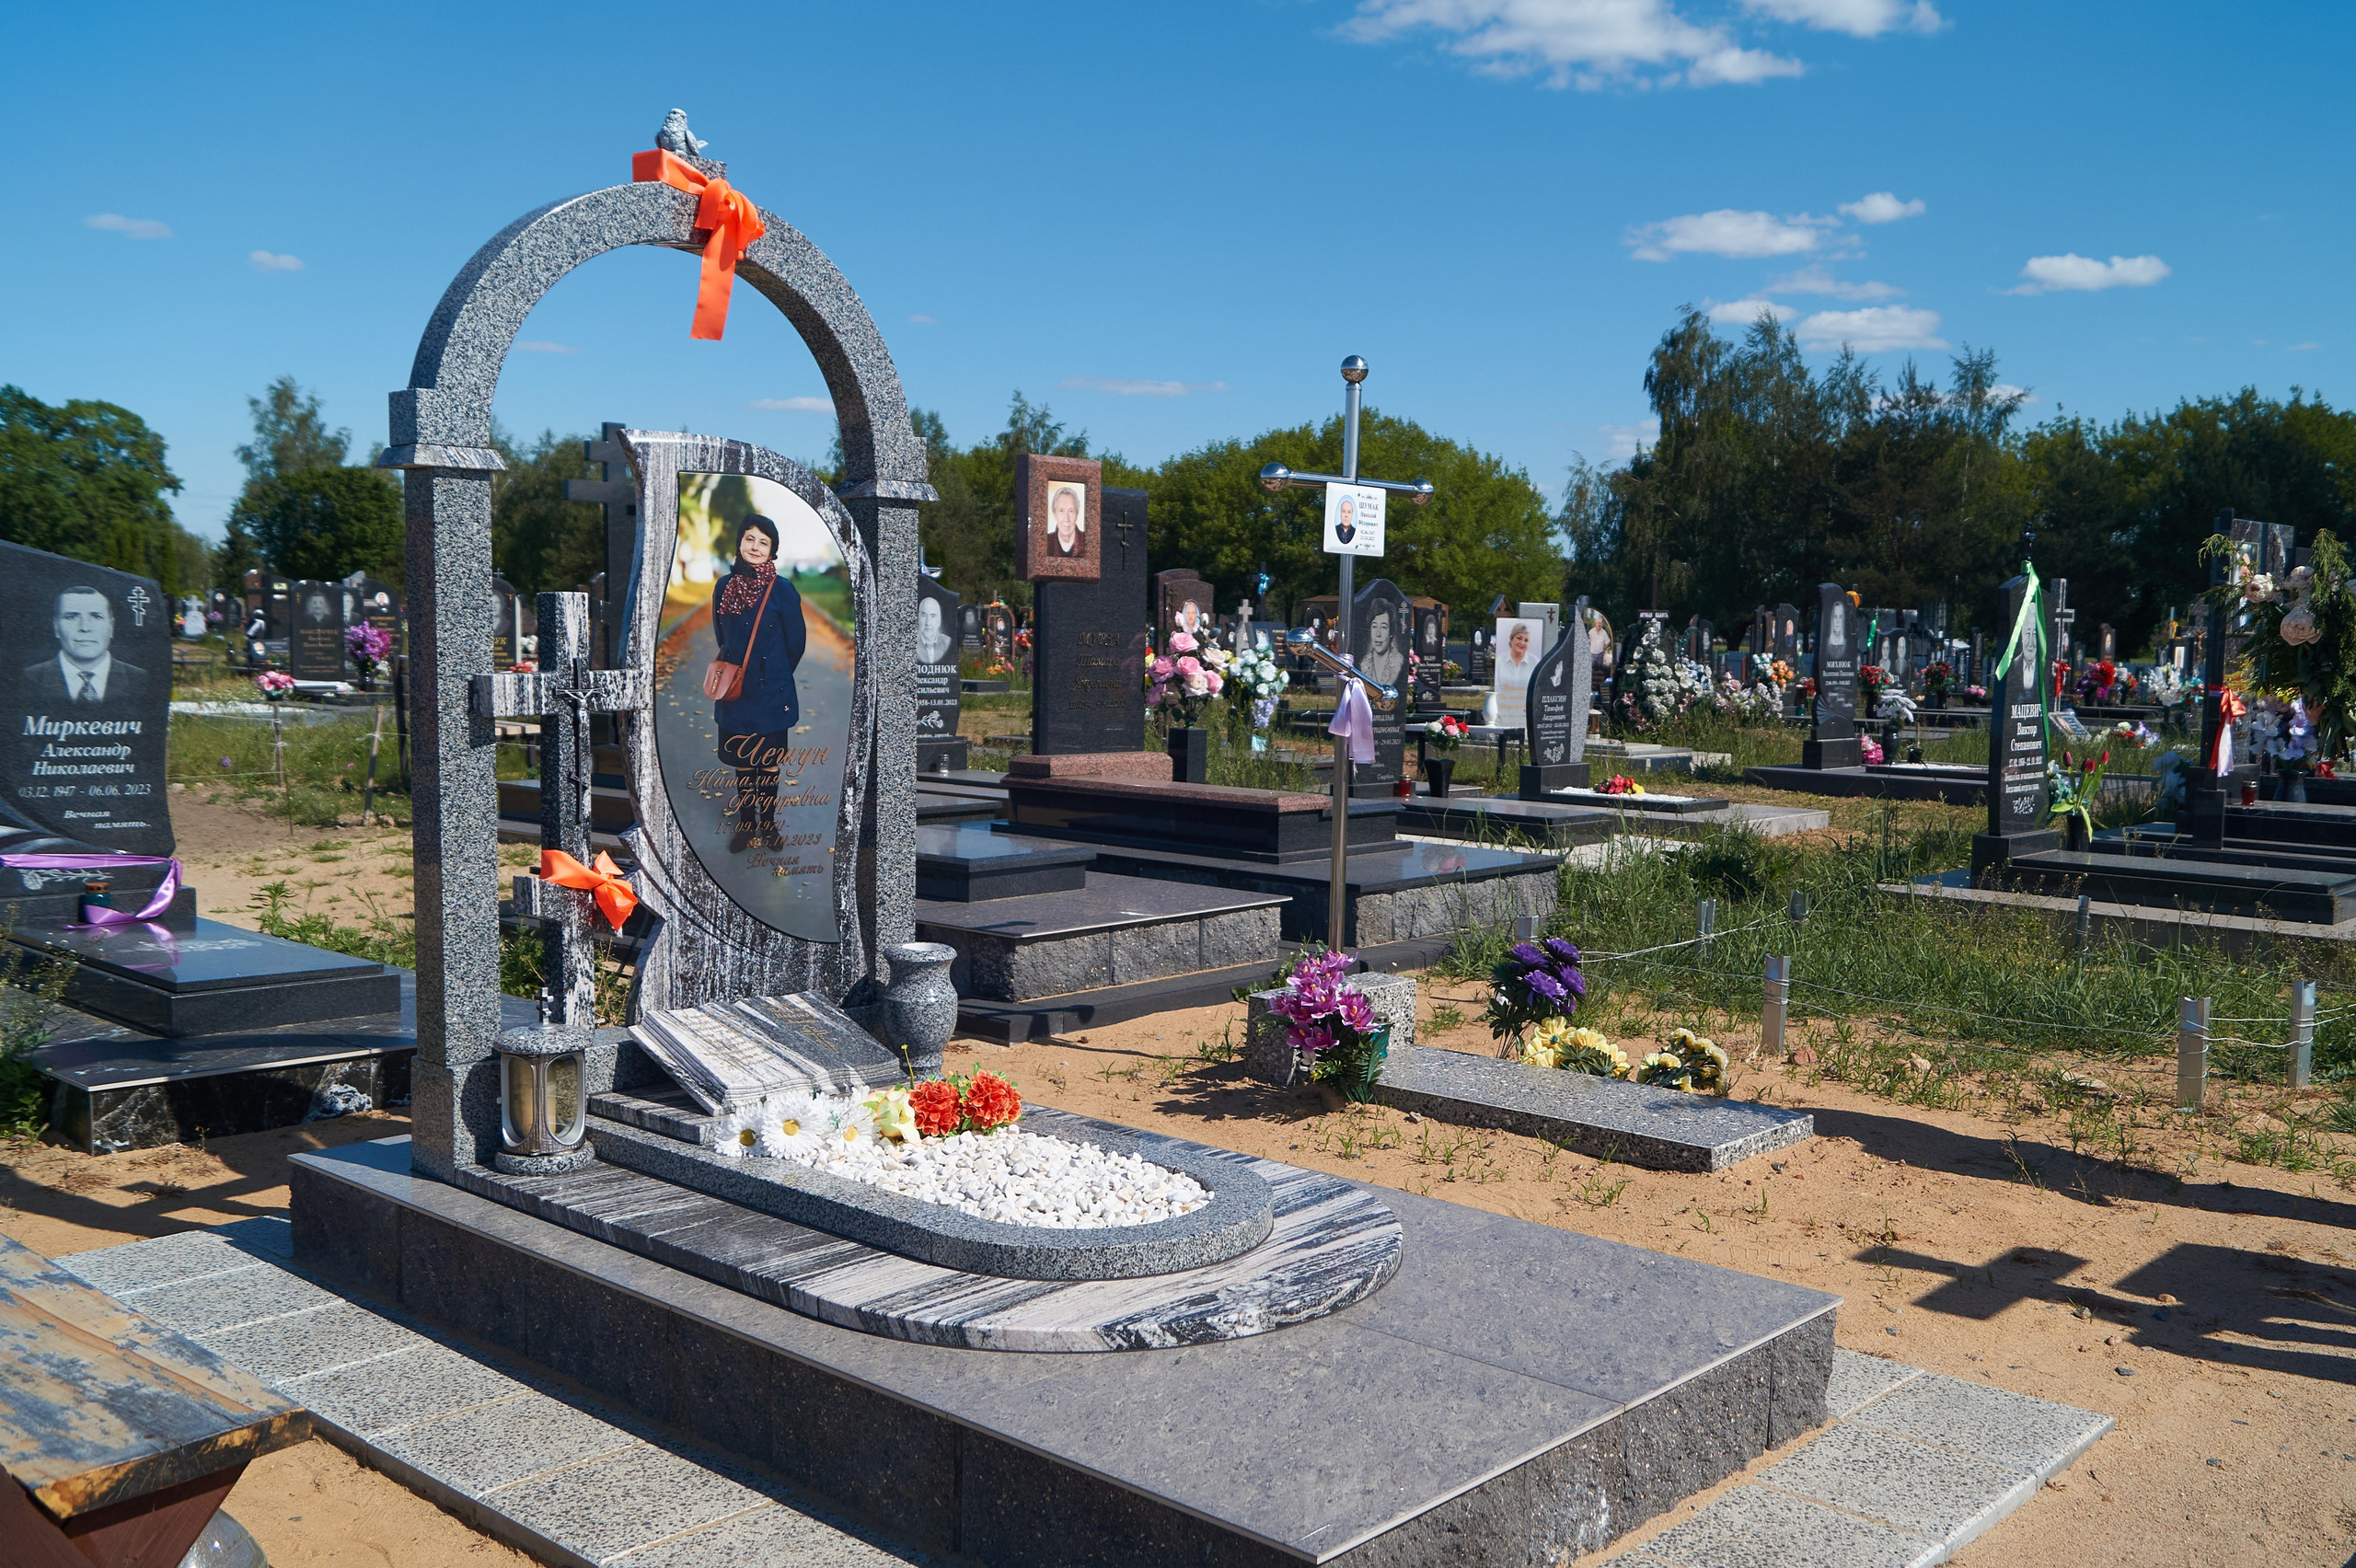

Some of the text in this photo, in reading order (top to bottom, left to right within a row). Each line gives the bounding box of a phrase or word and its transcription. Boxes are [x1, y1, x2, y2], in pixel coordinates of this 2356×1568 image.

[1358, 502, 1379, 511] ШУМАК
[1078, 632, 1121, 646] МУРЗА
[23, 715, 142, 742] Миркевич
[2016, 722, 2038, 737] Виктор
[40, 742, 132, 760] Александр
[2010, 739, 2042, 752] Степанович
[31, 761, 135, 776] Николаевич
[687, 767, 780, 790] Наталия
[124, 783, 152, 795] 2023
[722, 785, 831, 814] Фёдоровна
[63, 810, 111, 819] Вечная
[747, 833, 822, 848] 5.10.2023
[746, 850, 800, 869] Вечная
